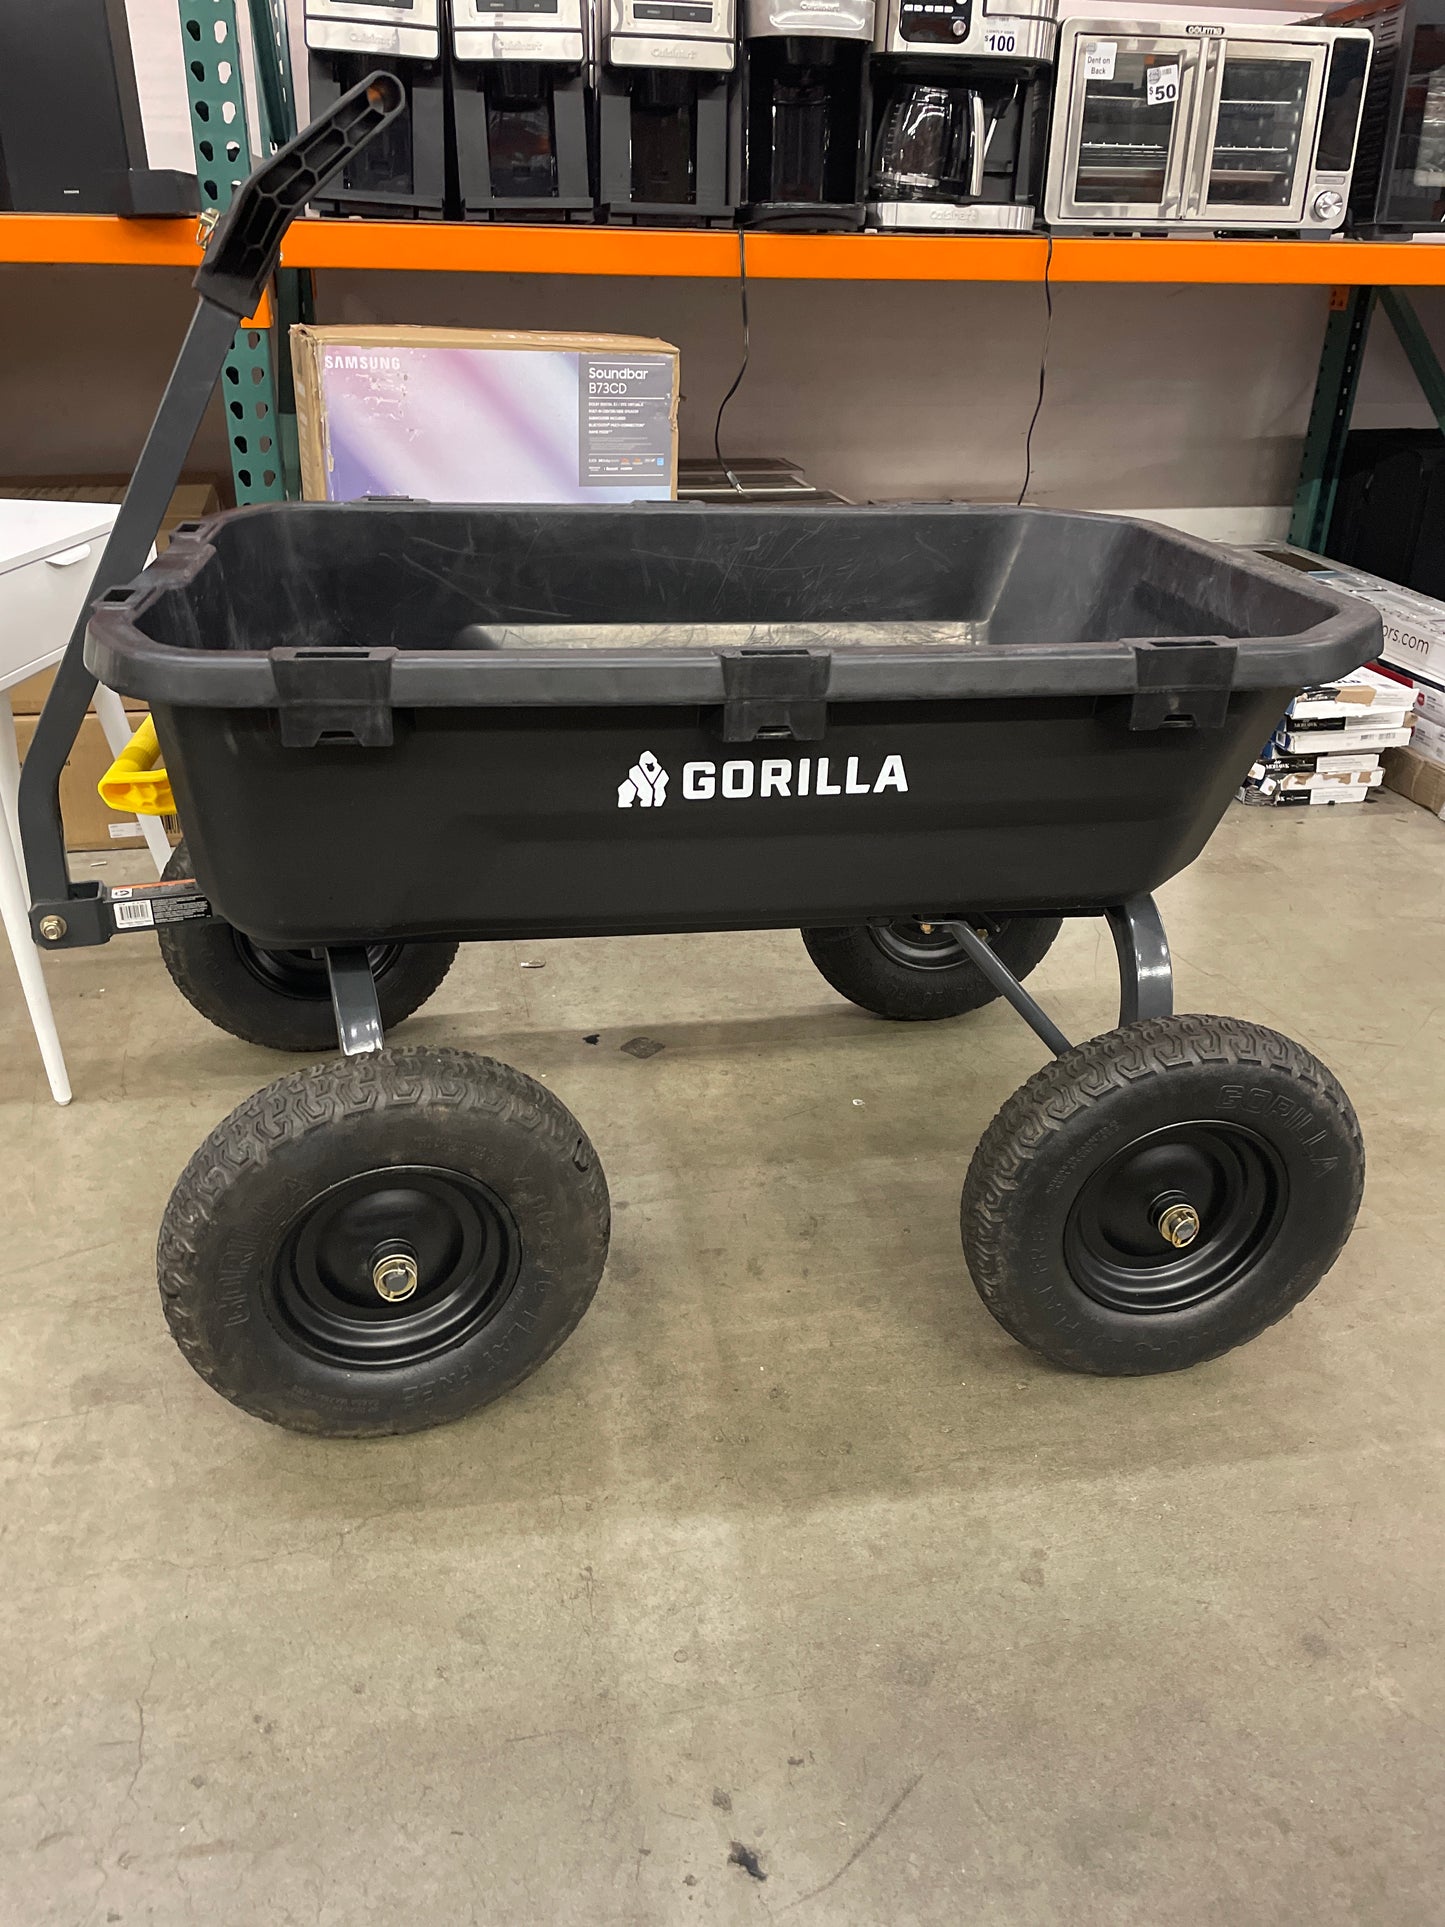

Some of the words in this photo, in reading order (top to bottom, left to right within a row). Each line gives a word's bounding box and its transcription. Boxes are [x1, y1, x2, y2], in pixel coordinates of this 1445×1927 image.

[984, 34, 1015, 52] $100
[1087, 56, 1102, 65] Dent
[1090, 67, 1106, 75] Back
[1149, 84, 1176, 101] $50
[324, 355, 401, 370] SAMSUNG
[588, 367, 648, 379] Soundbar
[588, 382, 627, 394] B73CD
[682, 754, 909, 800] GORILLA
